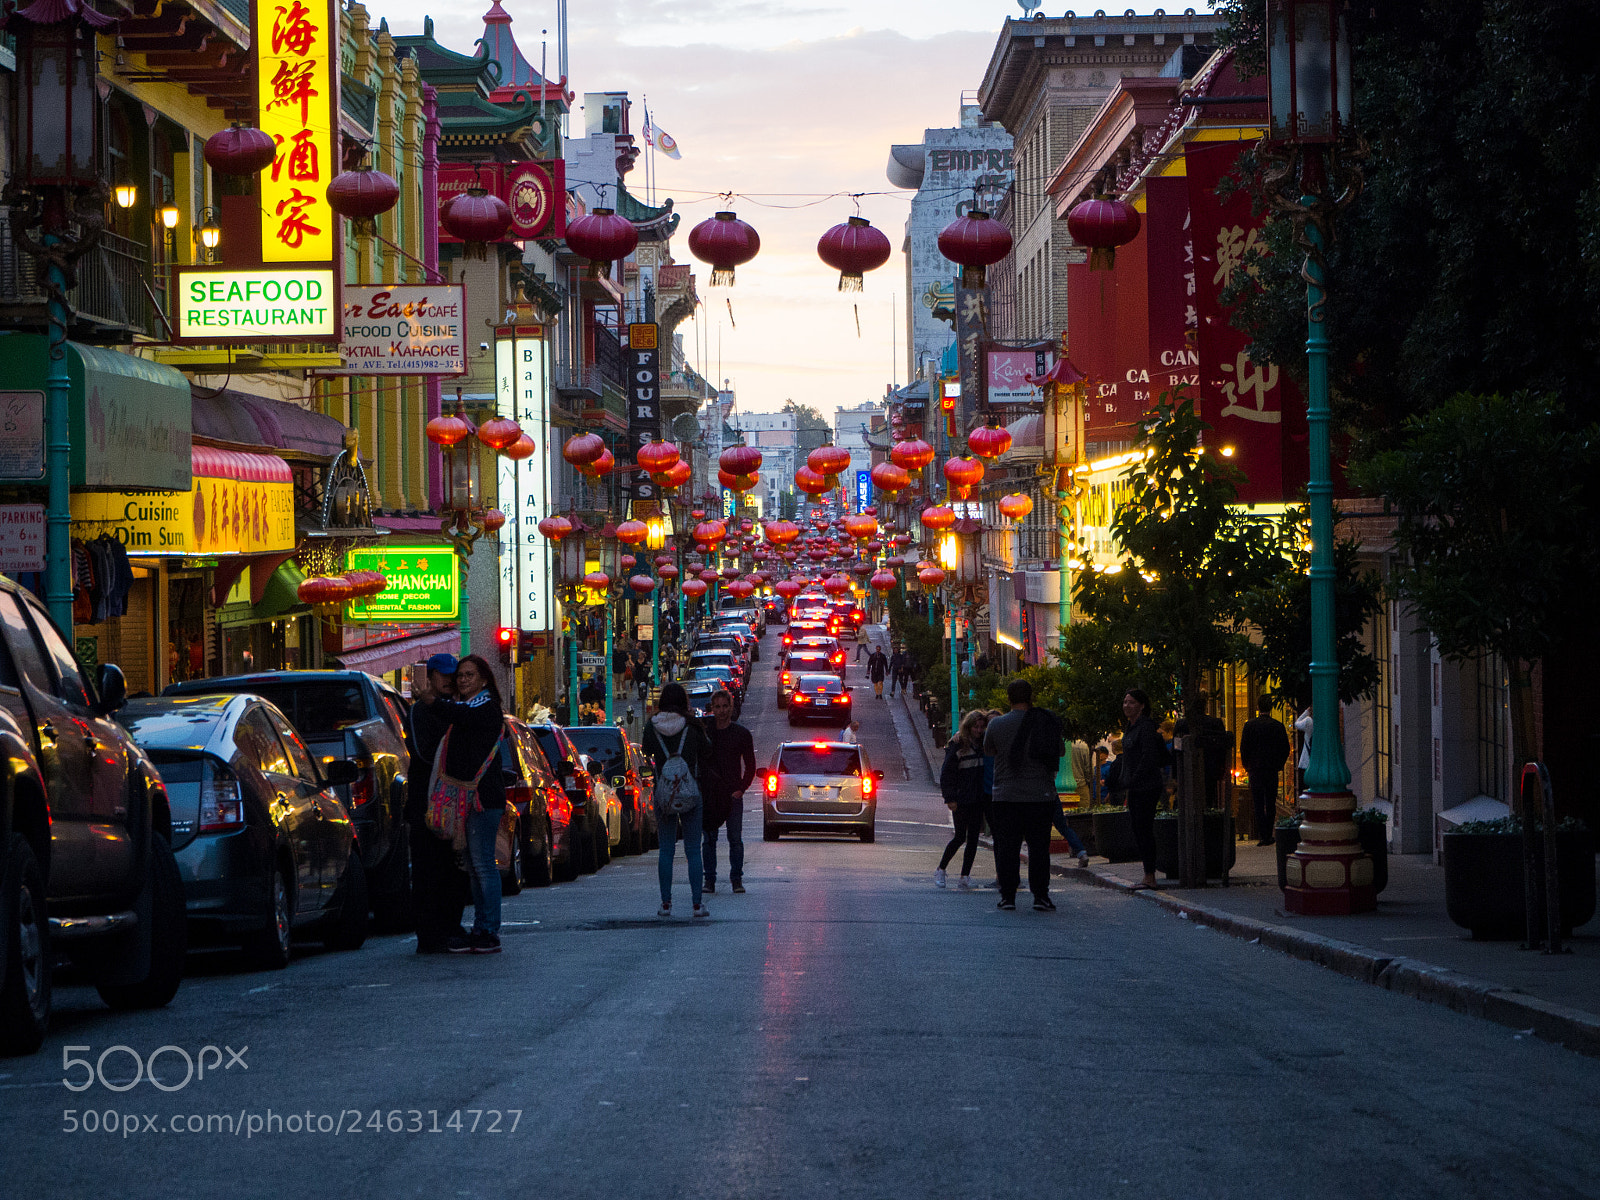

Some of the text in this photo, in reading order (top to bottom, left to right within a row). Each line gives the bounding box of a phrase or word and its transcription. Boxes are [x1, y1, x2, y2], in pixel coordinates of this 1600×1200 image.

[190, 280, 322, 302] SEAFOOD
[367, 291, 428, 319] East
[428, 302, 458, 318] CAFÉ
[187, 308, 327, 326] RESTAURANT
[397, 320, 457, 337] CUISINE
[523, 350, 533, 420] Bank
[637, 353, 653, 418] FOUR
[638, 432, 652, 497] SAS
[2, 511, 41, 524] PARKING
[124, 502, 179, 521] Cuisine
[20, 529, 26, 540] 6
[116, 527, 184, 546] Dim Sum
[24, 545, 36, 555] FRI
[525, 494, 538, 620] America
[385, 574, 451, 590] SHANGHAI
